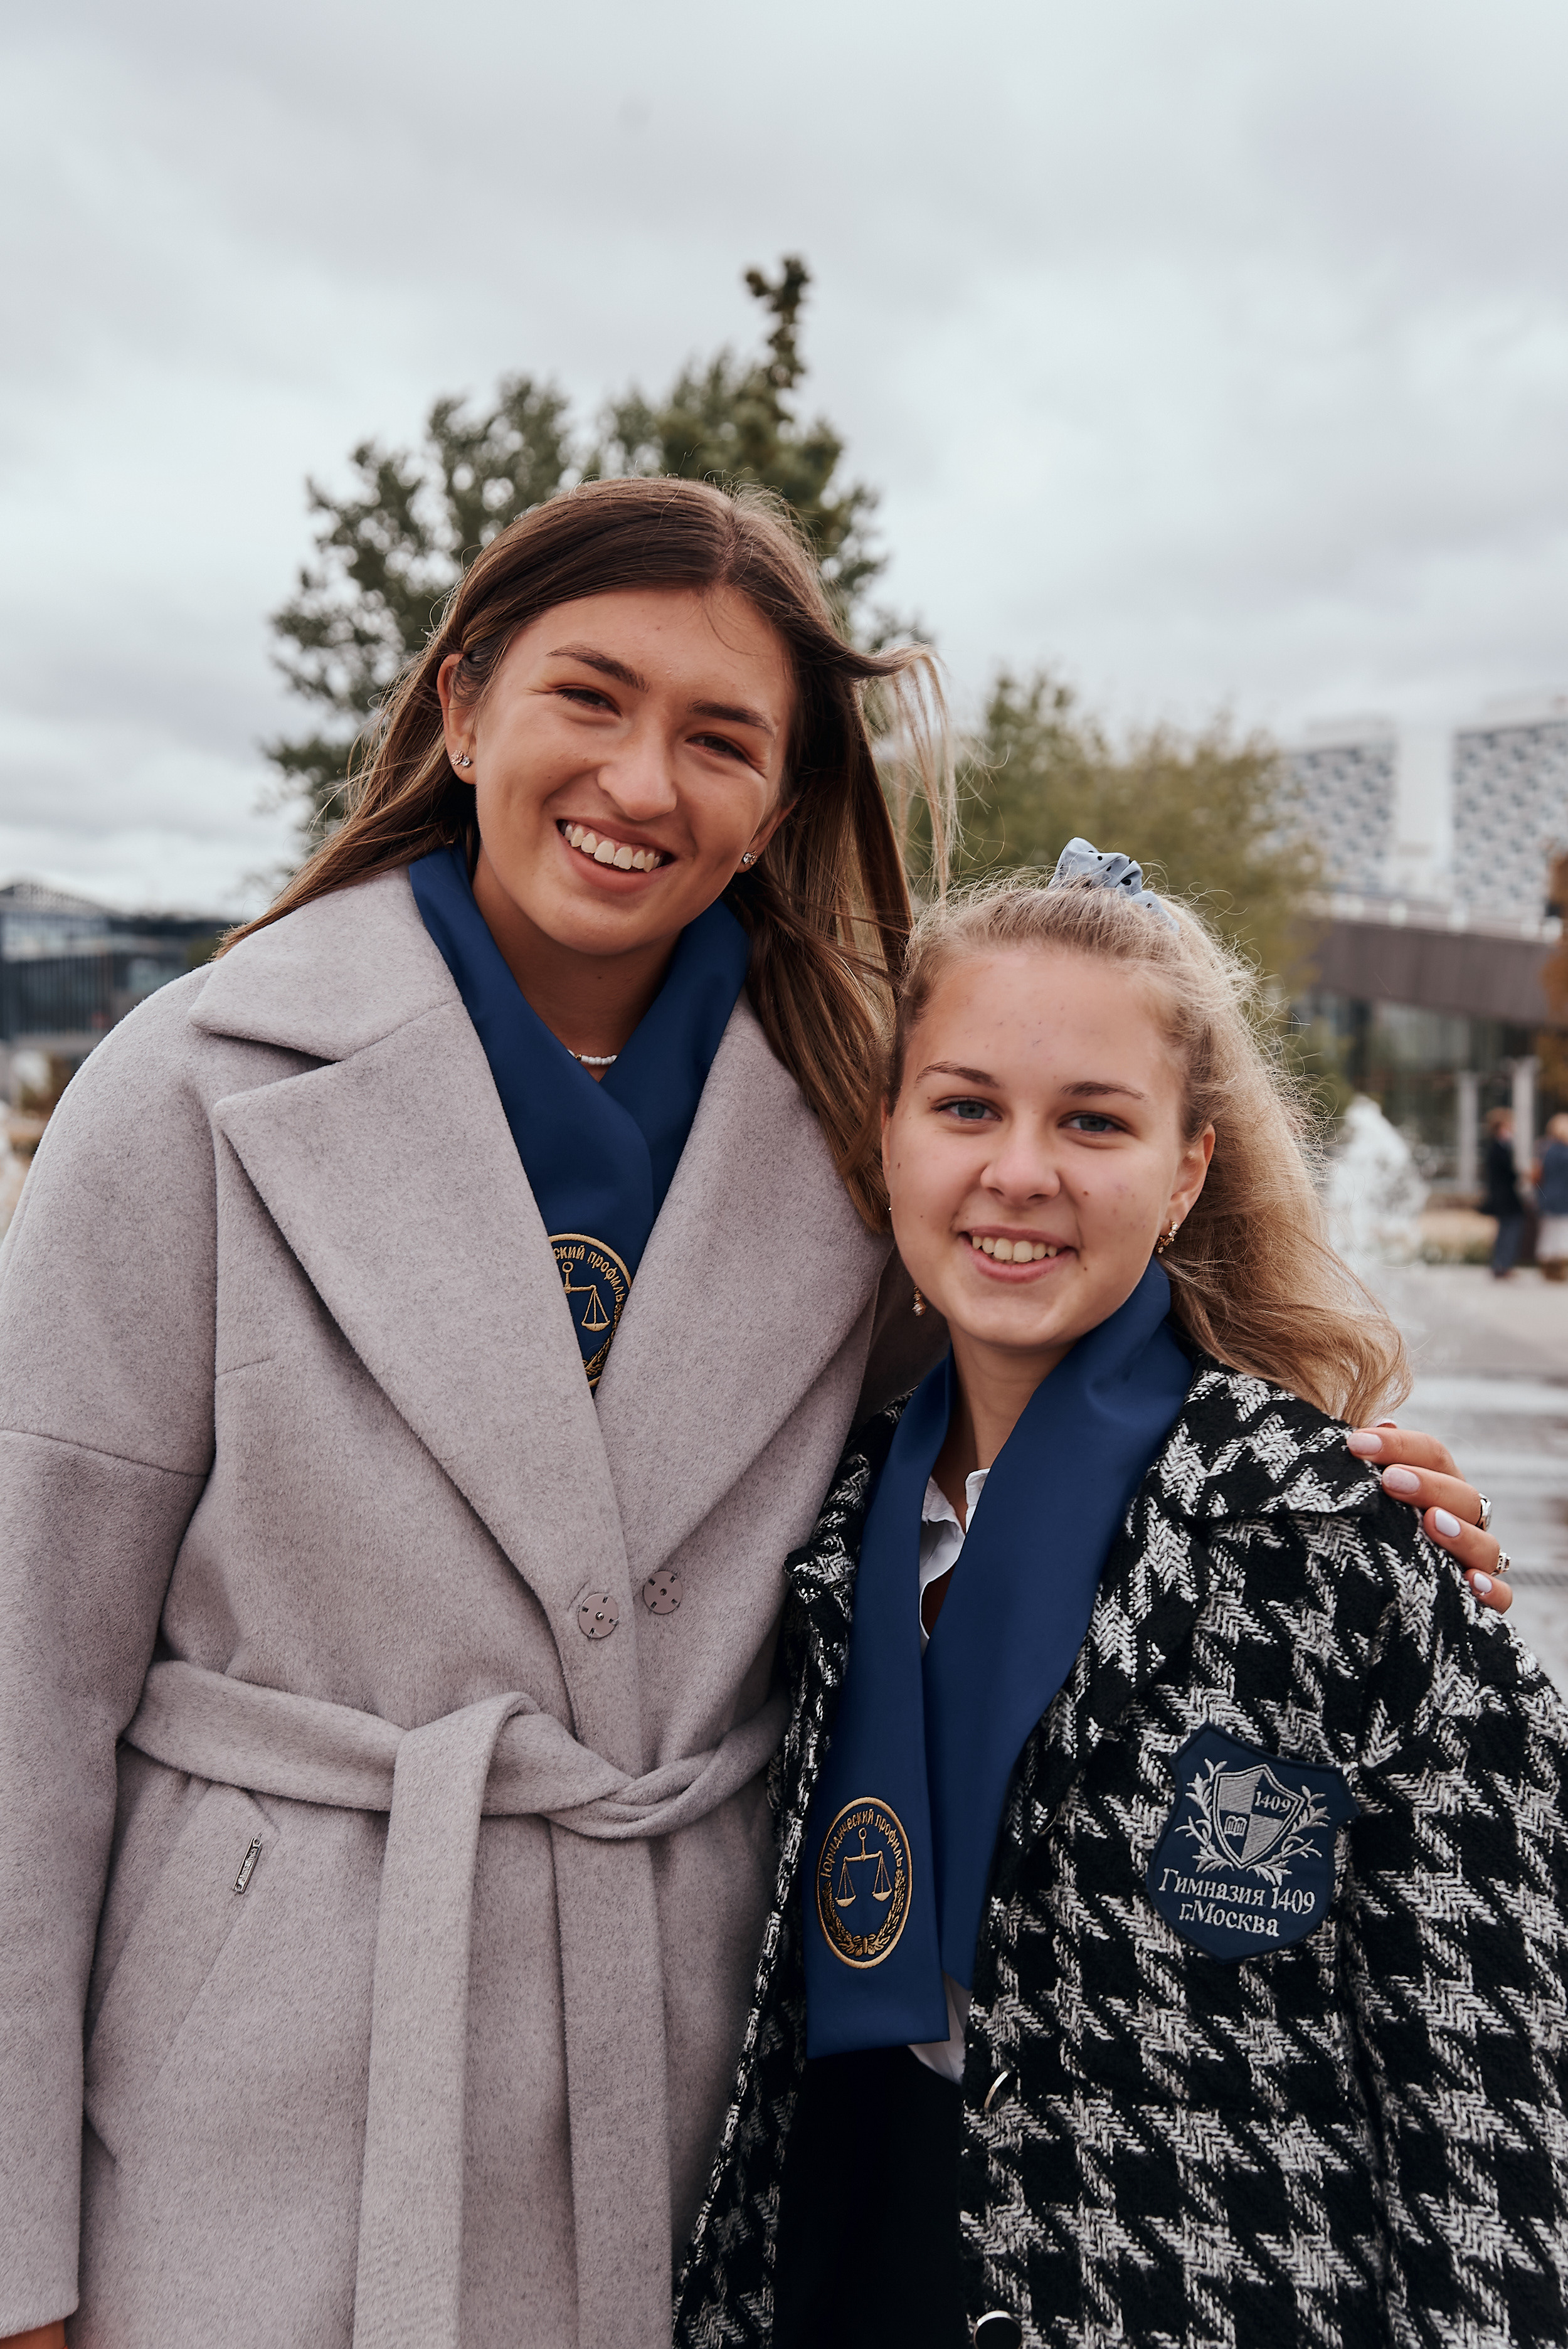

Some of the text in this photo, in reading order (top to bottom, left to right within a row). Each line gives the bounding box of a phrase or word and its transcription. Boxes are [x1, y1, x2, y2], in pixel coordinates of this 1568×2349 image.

[553, 1245, 626, 1303] ский профиль
[1254, 1791, 1291, 1813] 1409
[820, 1808, 903, 1878] Юридический профиль
[1158, 1867, 1316, 1914] Гимназия 1409
[1179, 1899, 1280, 1938] г.Москва
